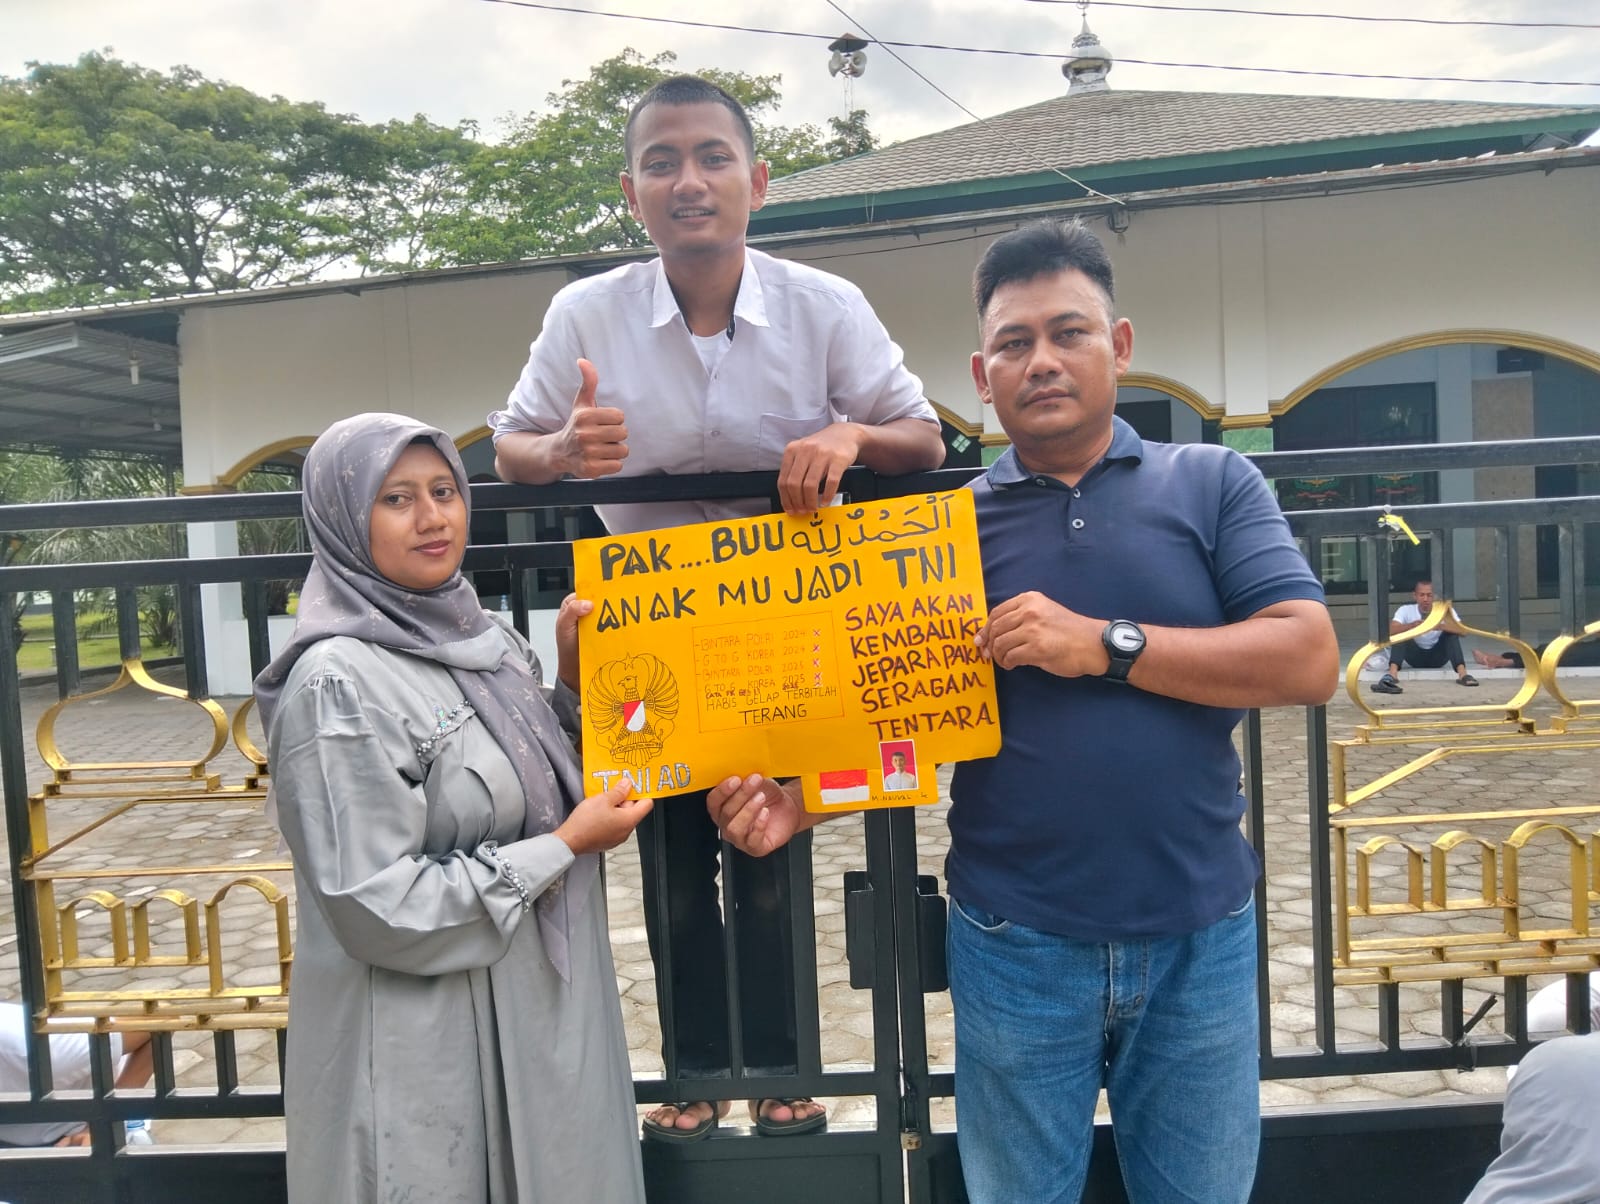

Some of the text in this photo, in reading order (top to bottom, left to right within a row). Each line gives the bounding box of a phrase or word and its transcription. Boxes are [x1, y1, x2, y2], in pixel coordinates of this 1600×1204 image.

[597, 542, 957, 633] ANAK MU JADI TNI
[845, 593, 974, 632] SAYA AKAN
[783, 629, 806, 641] 2024
[850, 619, 956, 659] KEMBALI
[714, 654, 727, 664] TO
[747, 648, 775, 661] KOREA
[852, 647, 941, 688] JEPARA
[706, 687, 838, 712] HABIS GELAP TERBITLAH
[714, 683, 726, 692] TO
[747, 678, 776, 691] KOREA
[861, 671, 987, 713] SERAGAM
[738, 703, 808, 725] TERANG
[869, 702, 996, 742] TENTARA
[657, 762, 691, 791] AD
